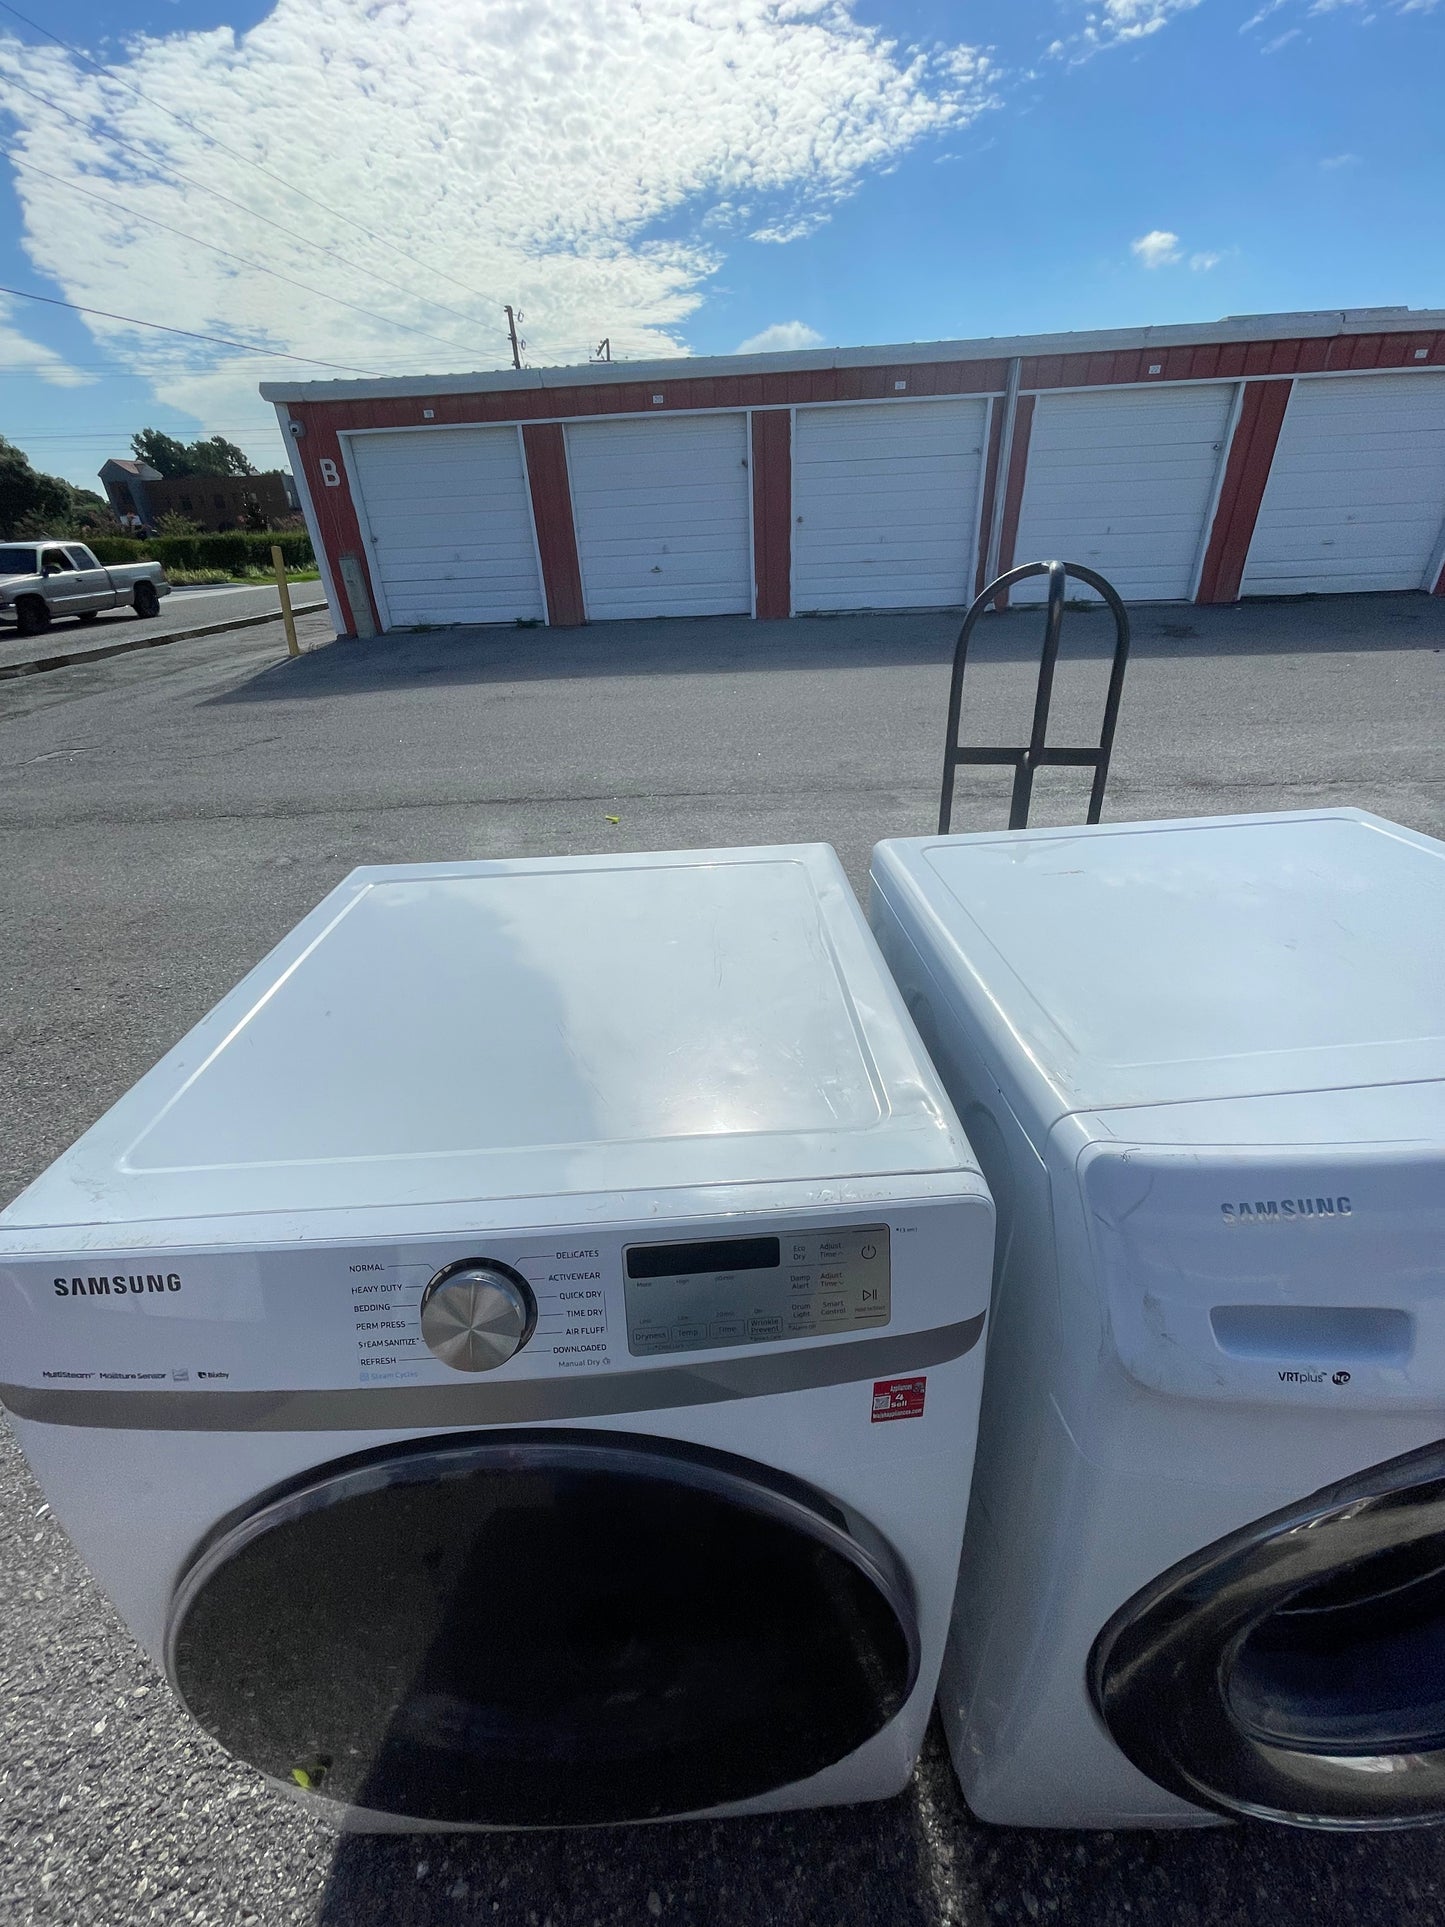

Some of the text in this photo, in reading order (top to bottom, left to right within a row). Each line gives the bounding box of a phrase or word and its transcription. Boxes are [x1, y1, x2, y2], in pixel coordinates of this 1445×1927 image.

[319, 458, 341, 487] B
[1221, 1197, 1352, 1224] SAMSUNG
[820, 1242, 841, 1251] Adjust
[556, 1249, 599, 1260] DELICATES
[349, 1263, 385, 1273] NORMAL
[548, 1271, 601, 1282] ACTIVEWEAR
[790, 1275, 810, 1283] Damp
[820, 1272, 843, 1281] Adjust
[53, 1273, 182, 1297] SAMSUNG
[351, 1284, 403, 1295] HEAVY DUTY
[791, 1282, 809, 1290] Alert
[559, 1290, 602, 1301] QUICK DRY
[354, 1304, 391, 1313] BEDDING
[792, 1303, 810, 1311] Drum
[821, 1307, 846, 1316] Control
[566, 1309, 603, 1317] TIME DRY
[356, 1320, 406, 1330] PERM PRESS
[565, 1326, 605, 1336] AIR FLUFF
[358, 1340, 384, 1349] STEAM
[553, 1344, 607, 1354] DOWNLOADED
[360, 1357, 397, 1367] REFRESH
[558, 1359, 600, 1368] Manual Dry
[895, 1393, 904, 1401] 4
